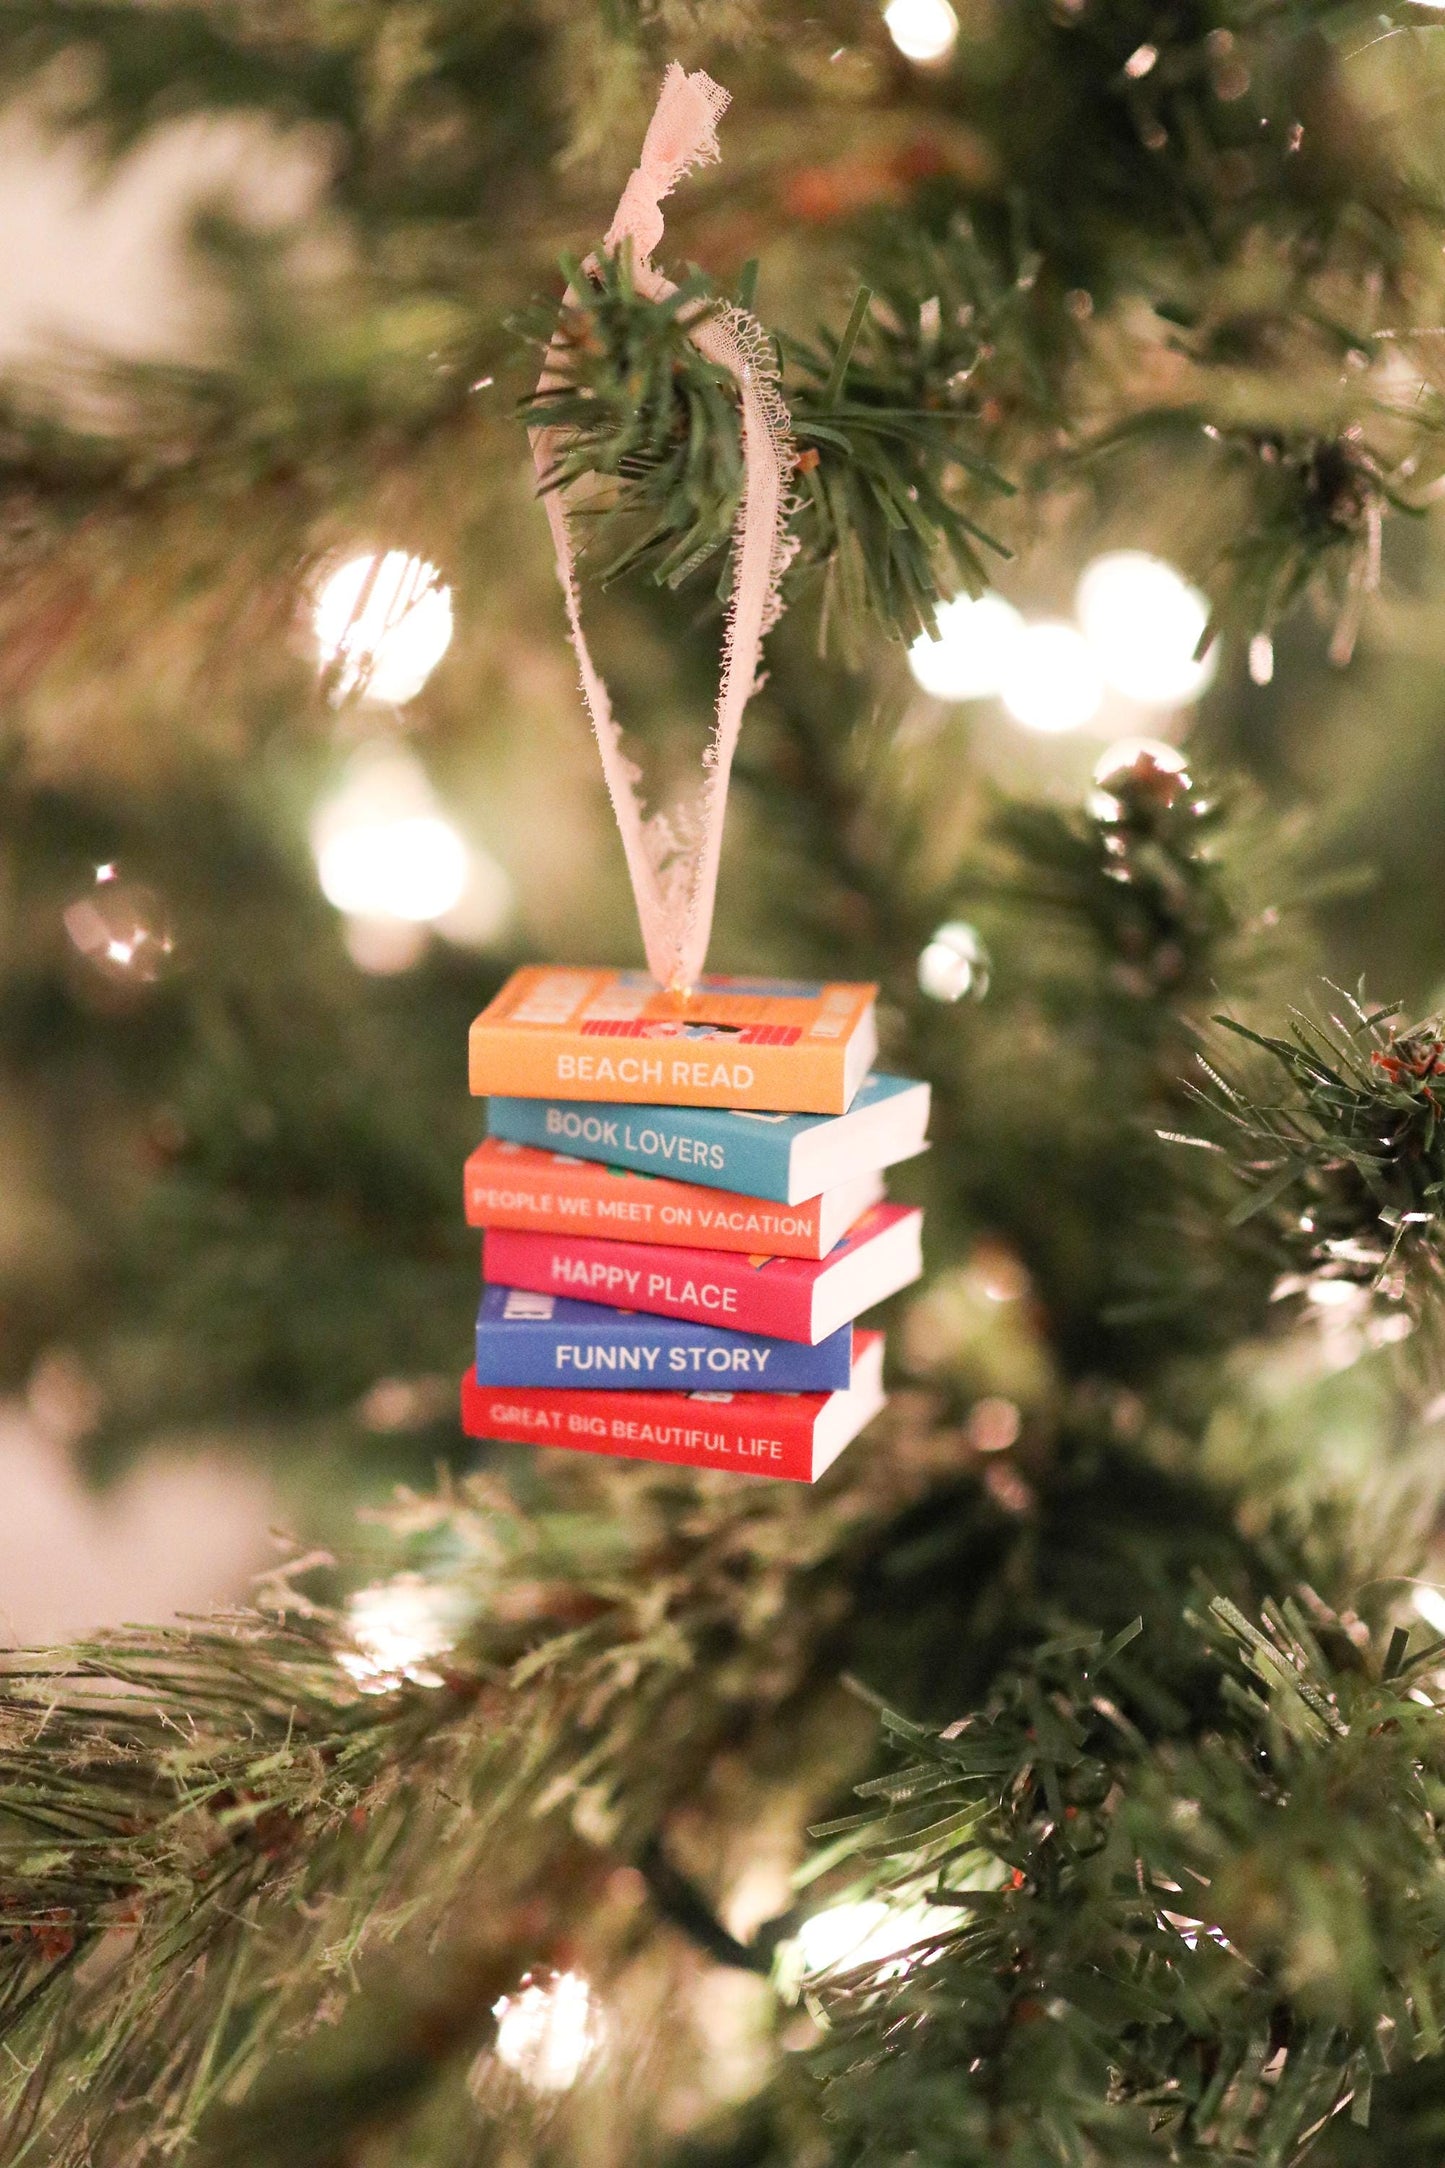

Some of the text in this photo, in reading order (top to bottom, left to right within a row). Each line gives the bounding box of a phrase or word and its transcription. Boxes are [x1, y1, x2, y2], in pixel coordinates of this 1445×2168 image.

[557, 1055, 755, 1090] BEACH READ
[546, 1108, 725, 1170] BOOK LOVERS
[473, 1188, 813, 1237] PEOPLE WE MEET ON VACATION
[551, 1256, 738, 1312] HAPPY PLACE
[555, 1346, 772, 1372] FUNNY STORY
[489, 1404, 784, 1461] GREAT BIG BEAUTIFUL LIFE
